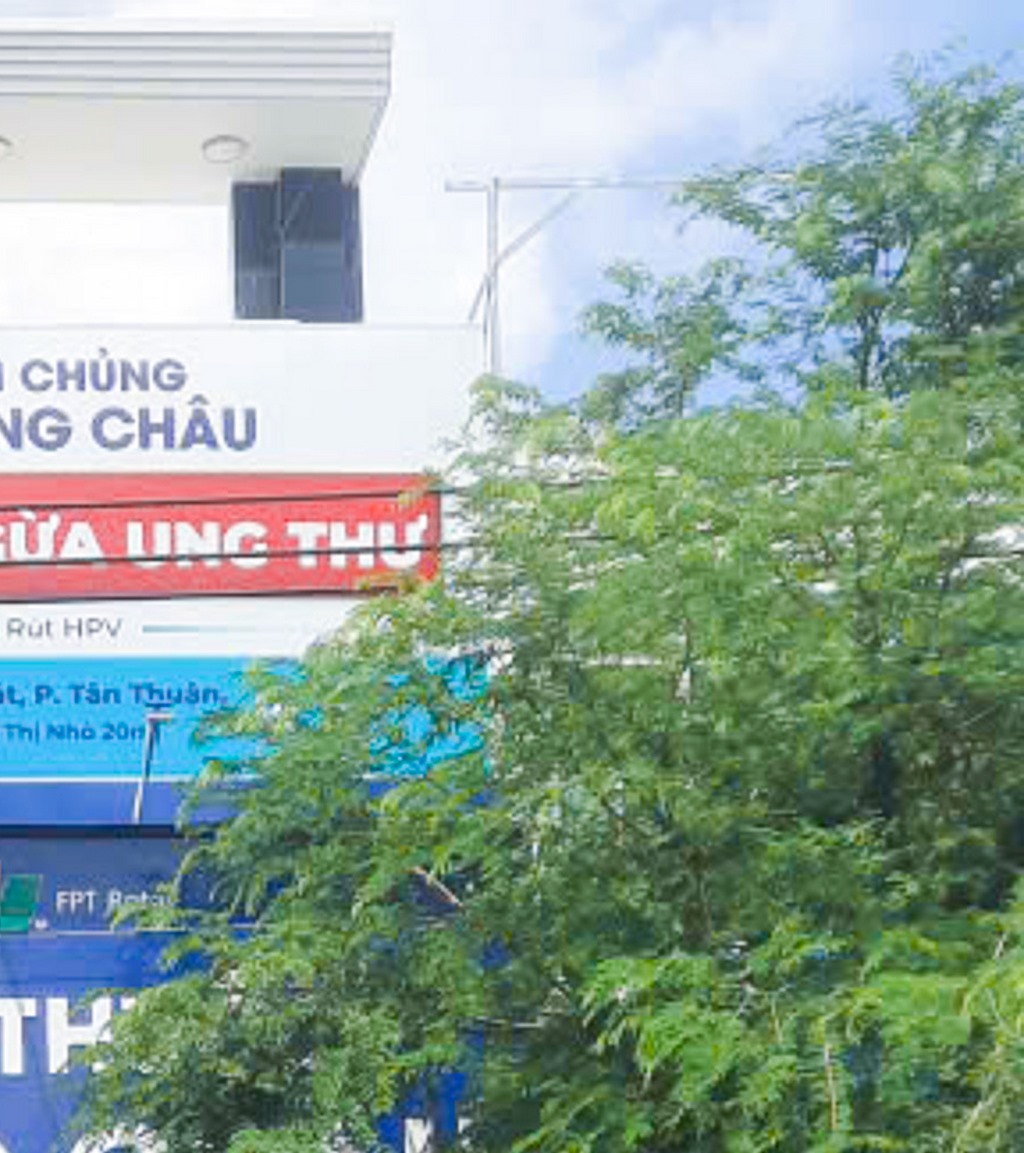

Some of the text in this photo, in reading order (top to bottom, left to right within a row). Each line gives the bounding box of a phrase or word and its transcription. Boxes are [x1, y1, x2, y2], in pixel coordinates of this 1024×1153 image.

[20, 348, 187, 392] CHỦNG
[91, 394, 258, 451] CHÂU
[286, 513, 428, 568] THƯ
[64, 617, 123, 638] HPV
[56, 890, 96, 914] FPT
